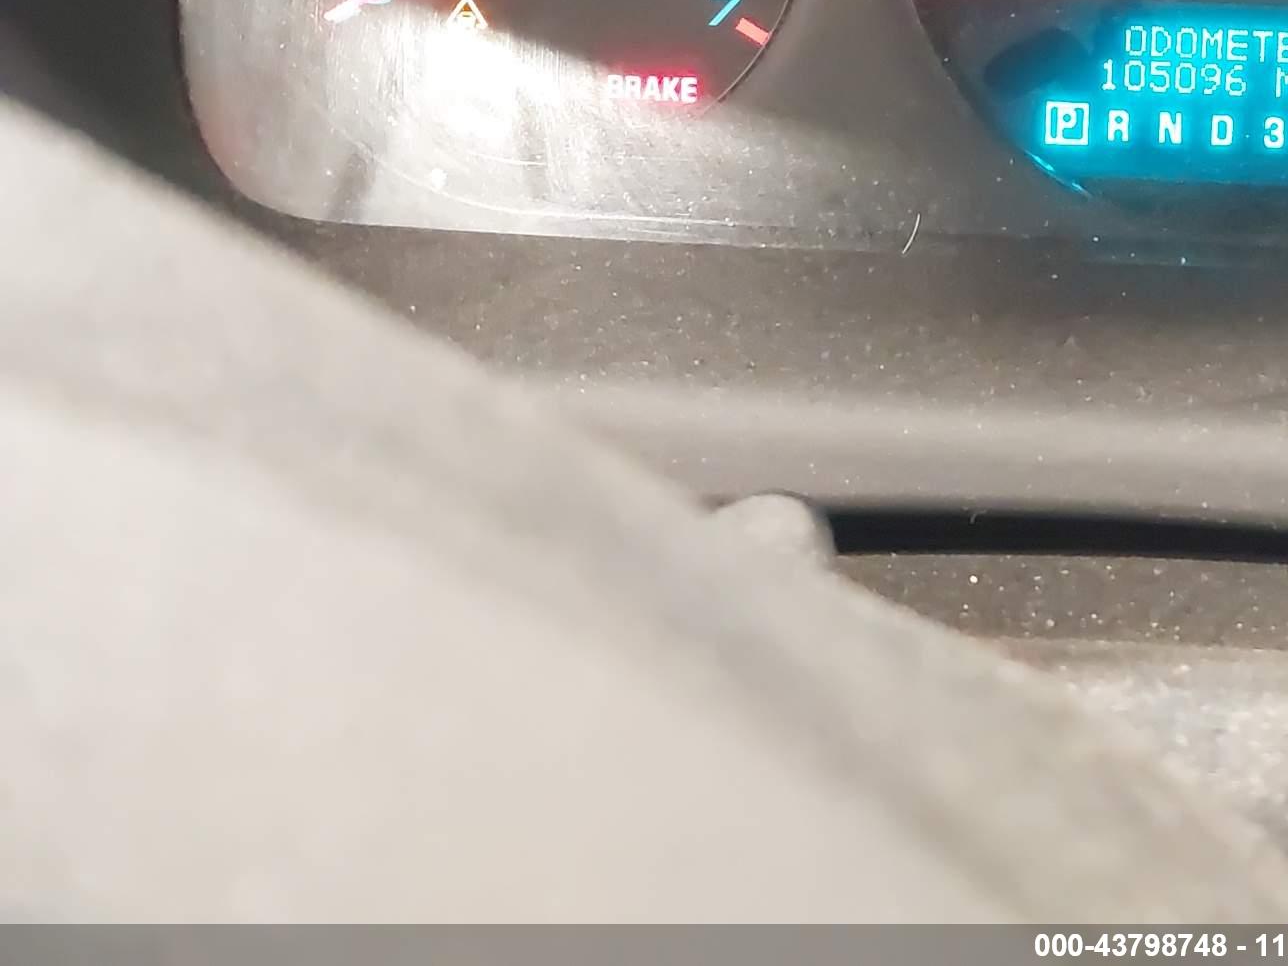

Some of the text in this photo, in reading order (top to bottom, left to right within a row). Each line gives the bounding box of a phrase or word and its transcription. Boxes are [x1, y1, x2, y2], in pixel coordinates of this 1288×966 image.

[607, 74, 698, 103] BRAKE
[1102, 58, 1247, 96] 105096
[1107, 109, 1130, 142] R
[1158, 111, 1183, 144] N
[1210, 115, 1234, 147] D
[1263, 116, 1285, 149] 3
